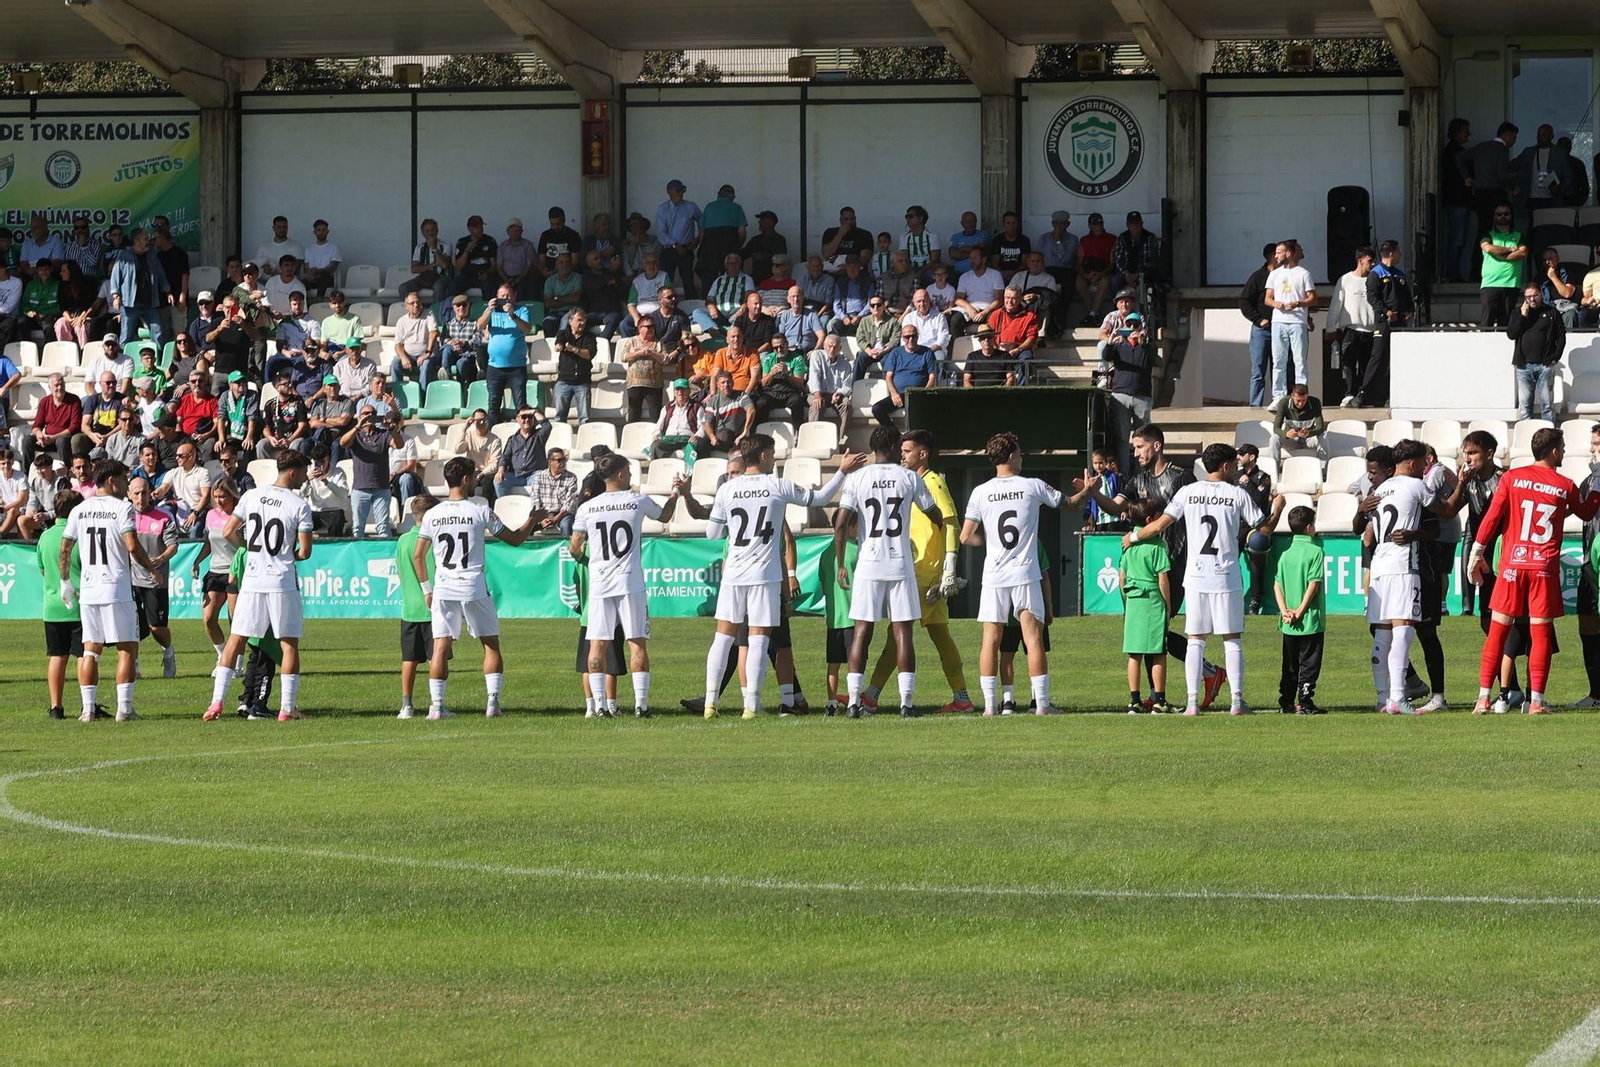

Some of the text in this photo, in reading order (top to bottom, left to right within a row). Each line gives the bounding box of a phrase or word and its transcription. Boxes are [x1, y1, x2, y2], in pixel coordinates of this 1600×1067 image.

[0, 122, 190, 141] DE TORREMOLINOS
[1048, 101, 1140, 153] JUVENTUD TORREMOLINOS C.F.
[114, 157, 184, 182] JUNTOS
[1080, 185, 1109, 194] 1958
[6, 209, 25, 225] EL
[111, 209, 130, 225] 12
[733, 489, 770, 499] ALONSO
[872, 480, 897, 489] ALSET
[1513, 478, 1567, 499] JAVI CUENCA
[260, 496, 282, 508] GORI
[988, 491, 1025, 502] CLIMENT
[1189, 494, 1234, 507] EDU LÓPEZ
[606, 503, 638, 512] GALLEGO
[865, 496, 905, 538] 23
[431, 516, 473, 527] CHRISTIAN
[730, 506, 774, 547] 24
[998, 510, 1020, 550] 6
[1520, 499, 1557, 544] 13
[248, 512, 285, 557] 20
[595, 519, 634, 561] 10
[1199, 514, 1219, 556] 2
[86, 526, 108, 566] 11
[438, 531, 469, 570] 21
[645, 586, 713, 598] NTAMIENTO
